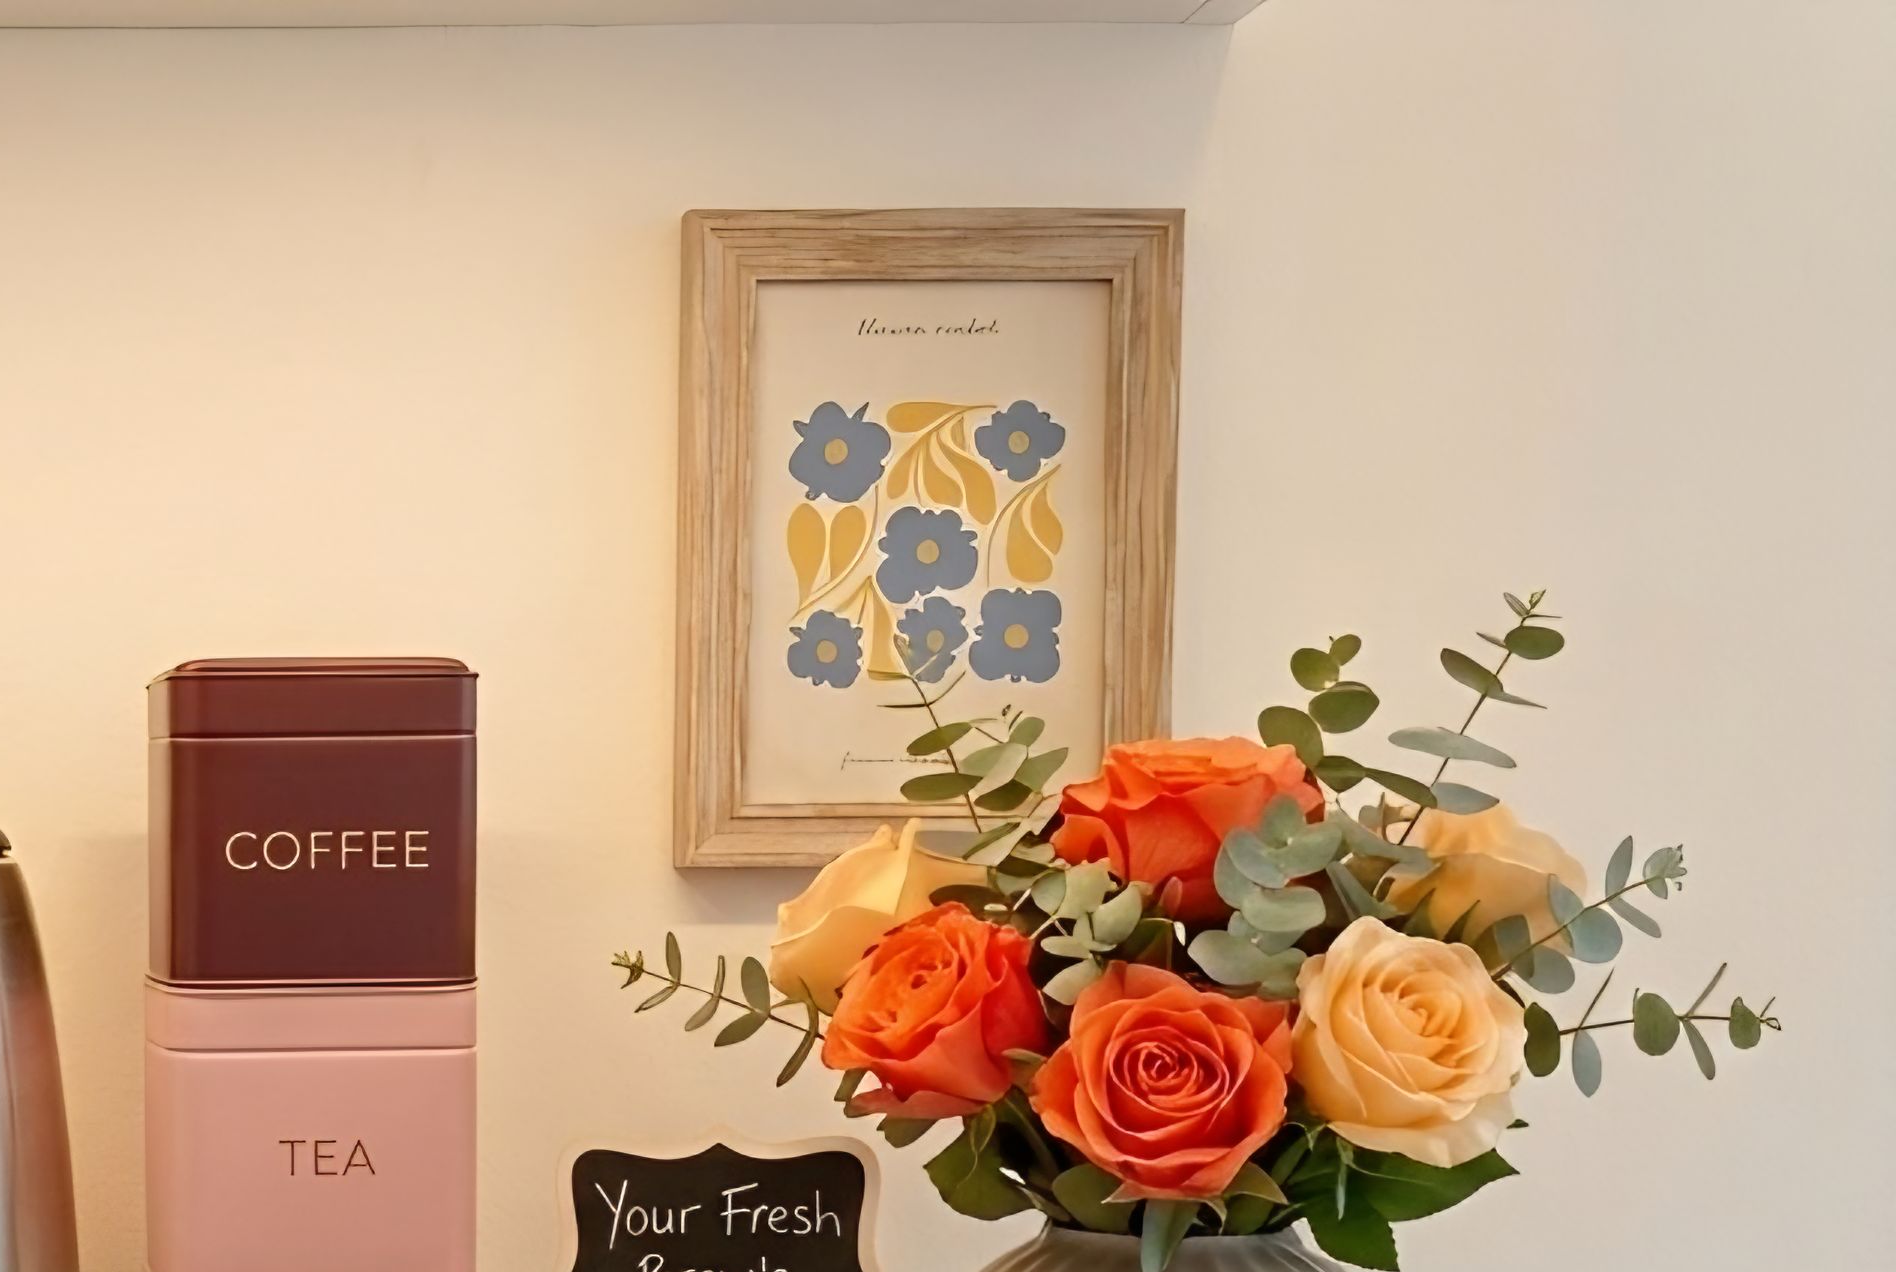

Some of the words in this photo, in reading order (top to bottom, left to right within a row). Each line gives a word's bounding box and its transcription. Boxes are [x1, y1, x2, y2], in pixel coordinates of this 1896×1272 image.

[225, 830, 430, 871] COFFEE
[278, 1139, 376, 1177] TEA
[594, 1178, 702, 1250] Your
[719, 1181, 842, 1238] Fresh
